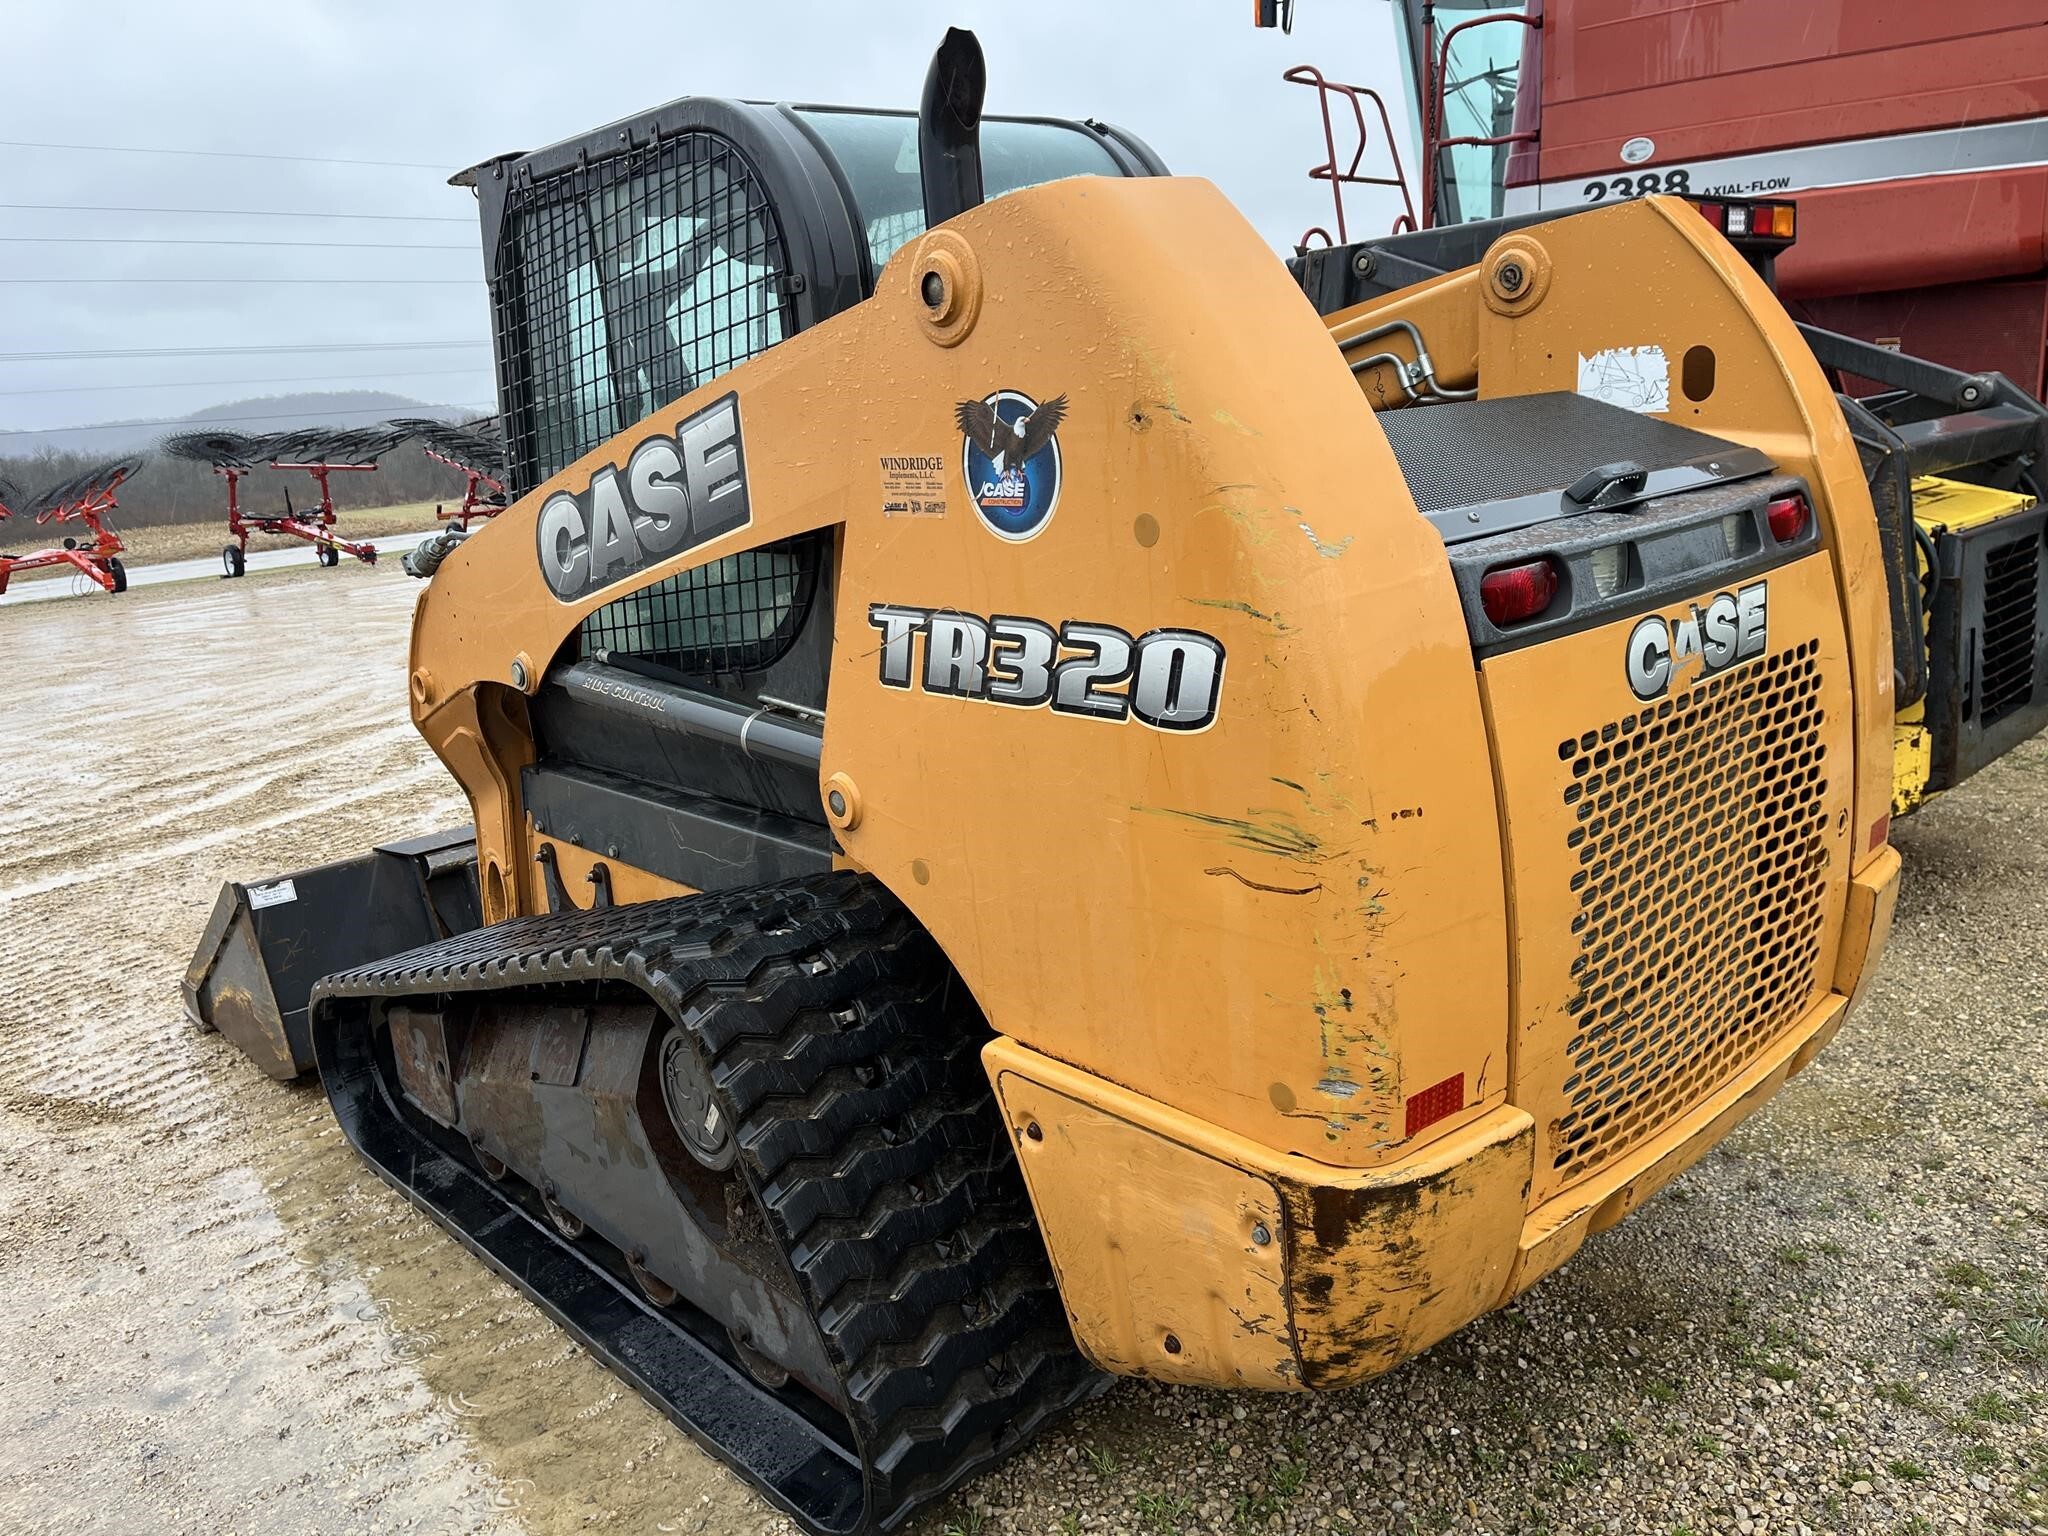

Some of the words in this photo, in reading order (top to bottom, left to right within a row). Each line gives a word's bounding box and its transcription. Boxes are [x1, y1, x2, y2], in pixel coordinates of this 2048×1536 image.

[1583, 169, 1690, 202] 2388
[1704, 177, 1791, 197] AXIAL-FLOW
[880, 457, 943, 471] WINDRIDGE
[889, 471, 919, 480] Implements,
[920, 471, 936, 479] L.L.C.
[538, 394, 748, 602] CASE
[983, 482, 1025, 498] CASE
[1625, 580, 1768, 703] CASE
[868, 602, 1226, 734] TR320
[582, 677, 613, 695] RIDE
[611, 686, 666, 712] CONTROL
